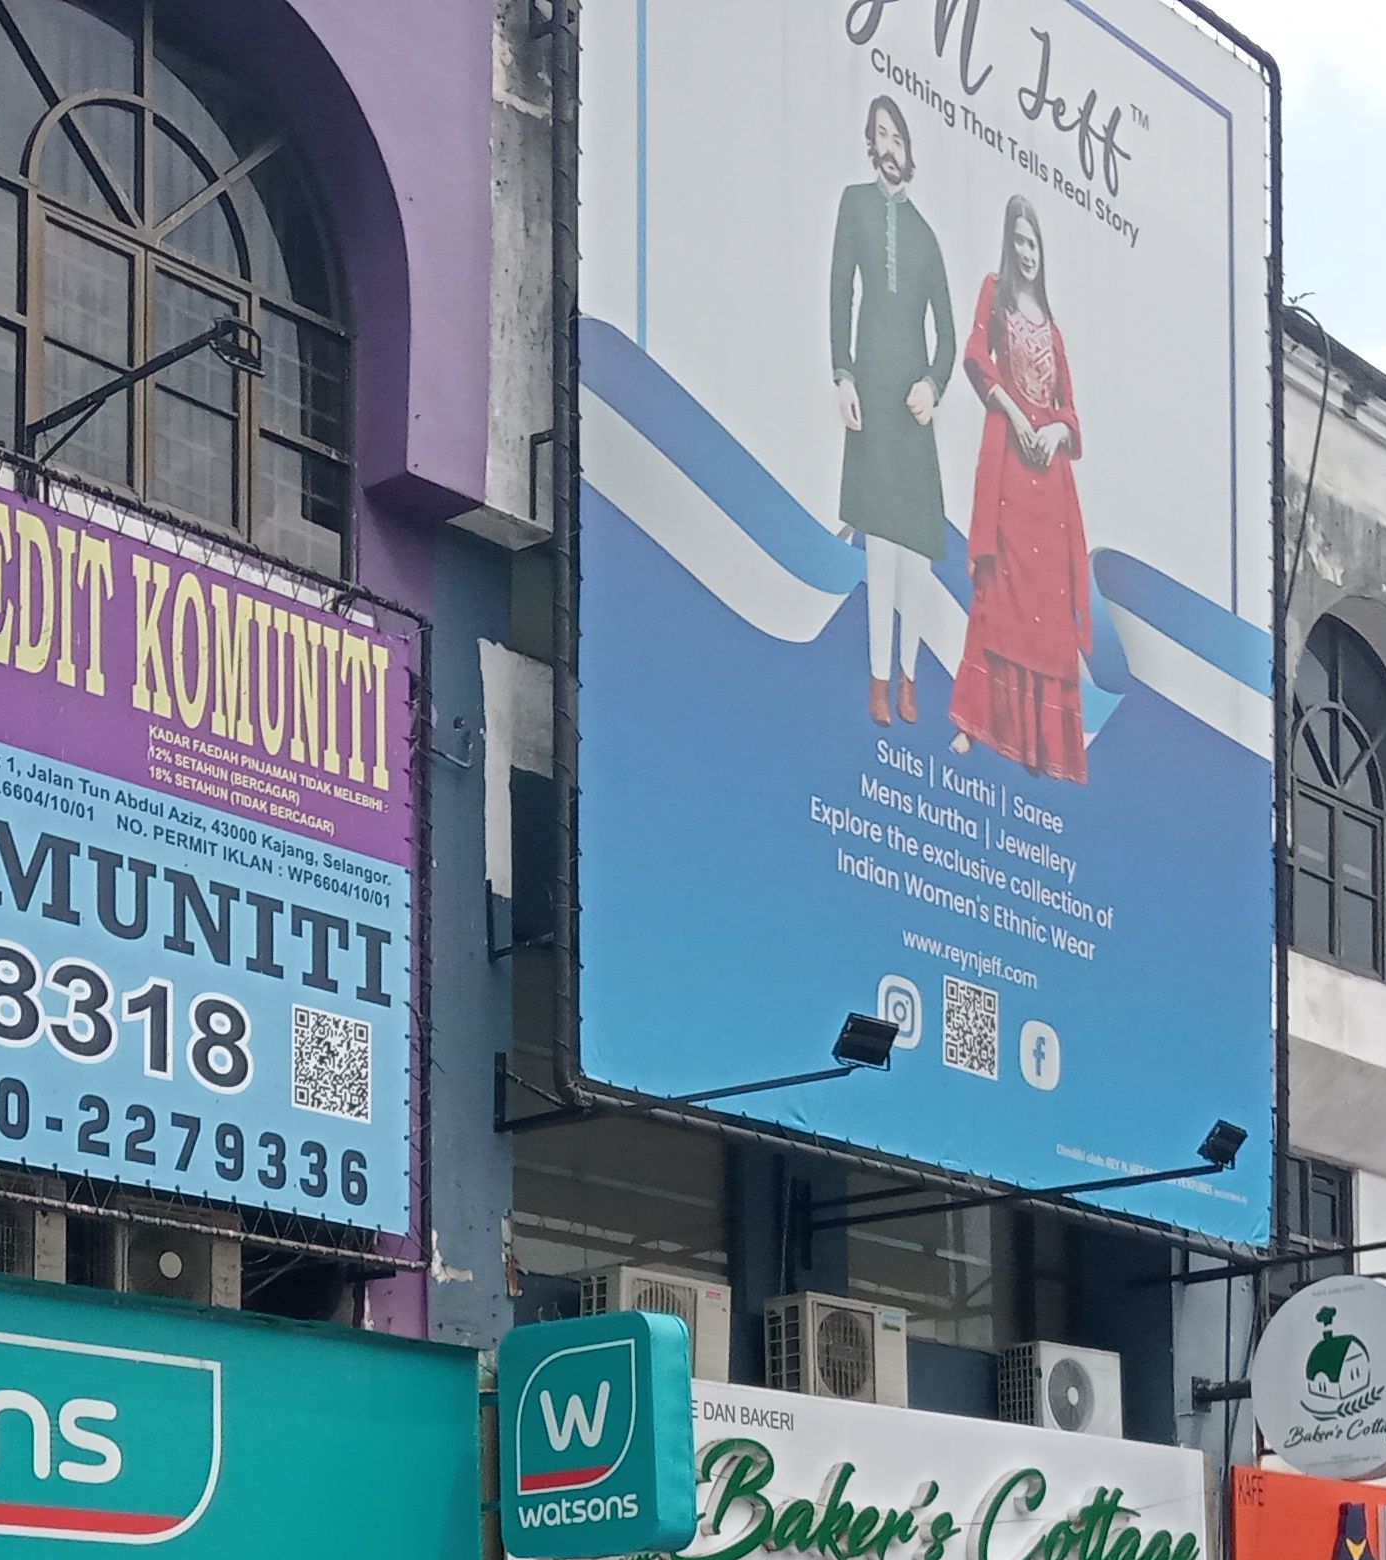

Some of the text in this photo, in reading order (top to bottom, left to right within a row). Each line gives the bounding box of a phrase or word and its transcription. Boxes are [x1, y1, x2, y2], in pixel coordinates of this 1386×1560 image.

[870, 47, 956, 128] Clothing
[960, 105, 1005, 154] That
[1007, 137, 1049, 182] Tells
[1053, 167, 1092, 210] Real
[1095, 192, 1140, 248] Story
[1018, 26, 1131, 196] Jeff
[131, 554, 390, 791] KOMUNITI
[148, 724, 383, 813] KADAR FAEDAH PINJAMAN TIDAK MELEBIHI
[148, 745, 301, 807] 12% SETAHUN (BERCAGAR)
[149, 765, 335, 837] 18% SETAHUN (TIDAK BERCAGAR)
[876, 738, 1064, 836] Suits Kurthi Saree
[26, 757, 74, 792] Jalan
[79, 772, 112, 803] Tun
[115, 789, 164, 818] Abdul
[168, 803, 207, 833] Aziz,
[211, 820, 257, 846] 43000
[262, 833, 319, 868] Kajang,
[322, 853, 393, 887] Selangor.
[116, 814, 391, 909] NO. PERMIT IKLAN WP6604/10/01
[810, 795, 1114, 930] Explore the exclusive collection of
[861, 773, 1077, 884] Mens kurtha Jewellery
[837, 847, 1096, 961] Indian Women's Ethnic Wear
[902, 929, 1038, 990] www.reynjeff.com
[703, 1401, 736, 1424] DAN
[740, 1406, 795, 1432] BAKERI
[1283, 1423, 1344, 1449] Baker's
[518, 1493, 639, 1529] watsons
